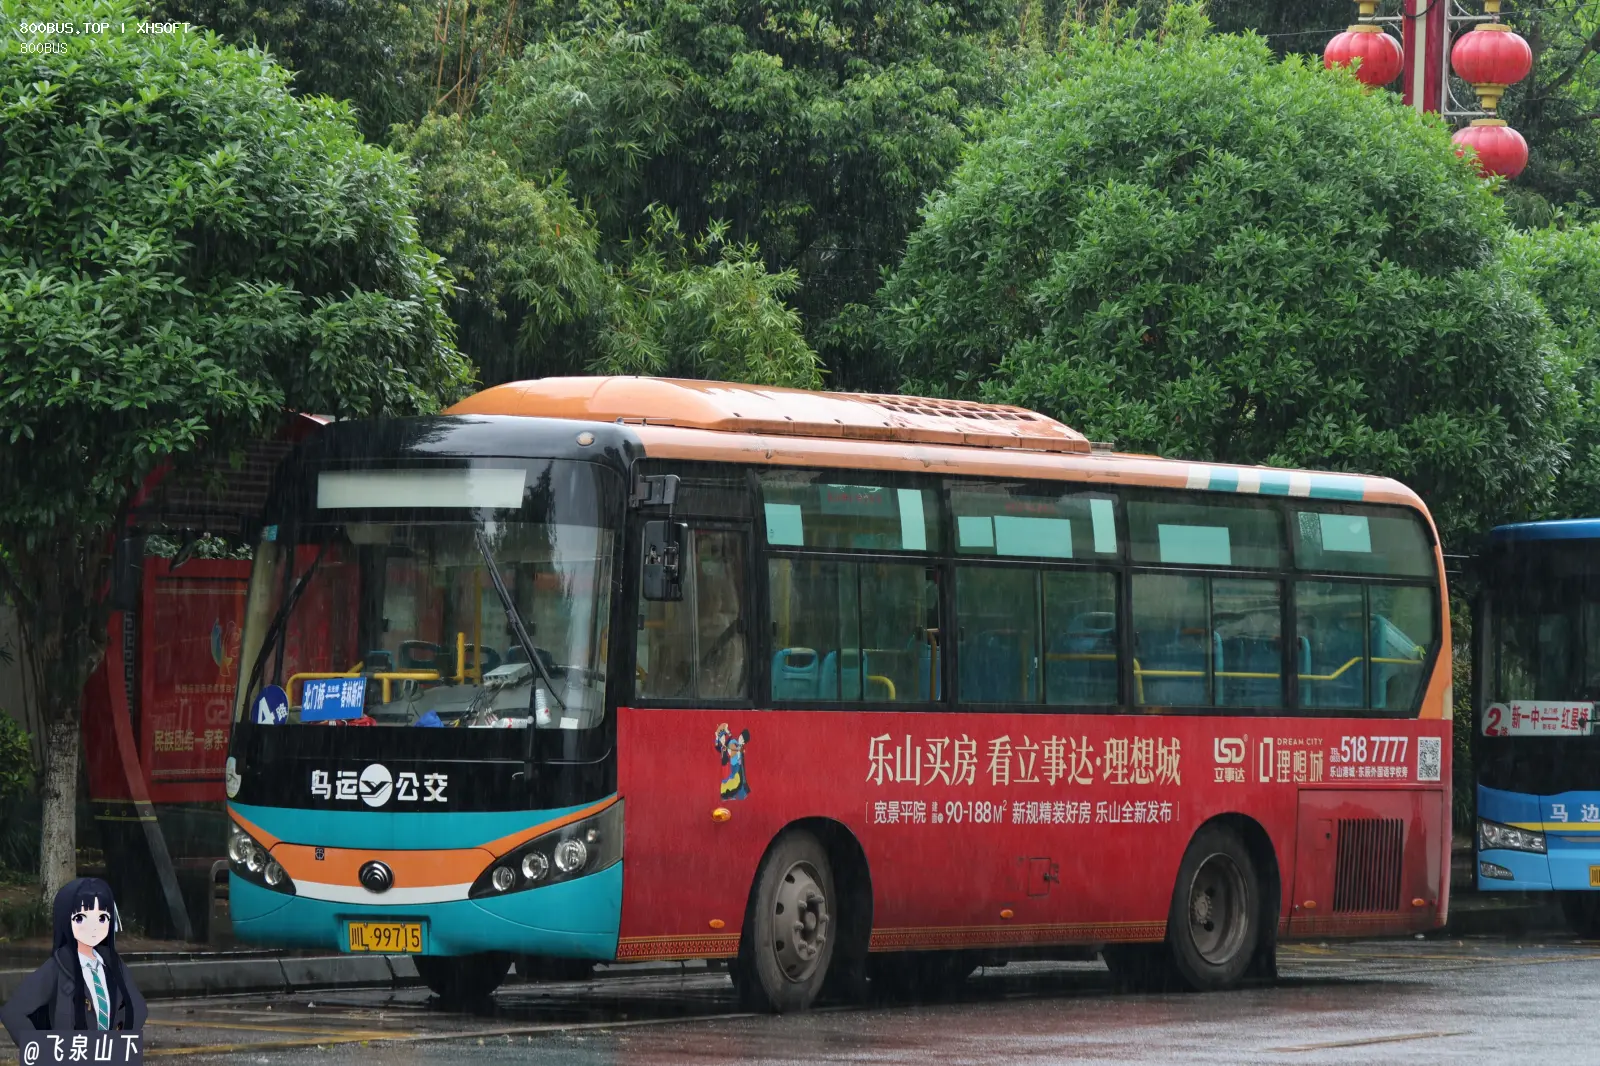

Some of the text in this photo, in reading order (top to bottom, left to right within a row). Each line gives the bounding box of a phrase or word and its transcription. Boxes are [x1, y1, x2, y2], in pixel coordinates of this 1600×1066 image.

[865, 733, 1182, 787] 乐山买房 看立事达·理想城
[1341, 736, 1408, 763] 518 7777
[1214, 767, 1245, 782] 立事达
[1276, 750, 1323, 782] 理想城
[396, 772, 448, 802] 公交
[874, 800, 926, 824] 宽景平院
[1012, 800, 1091, 824] 新规精装好房
[1095, 801, 1172, 824] 乐山全新发布
